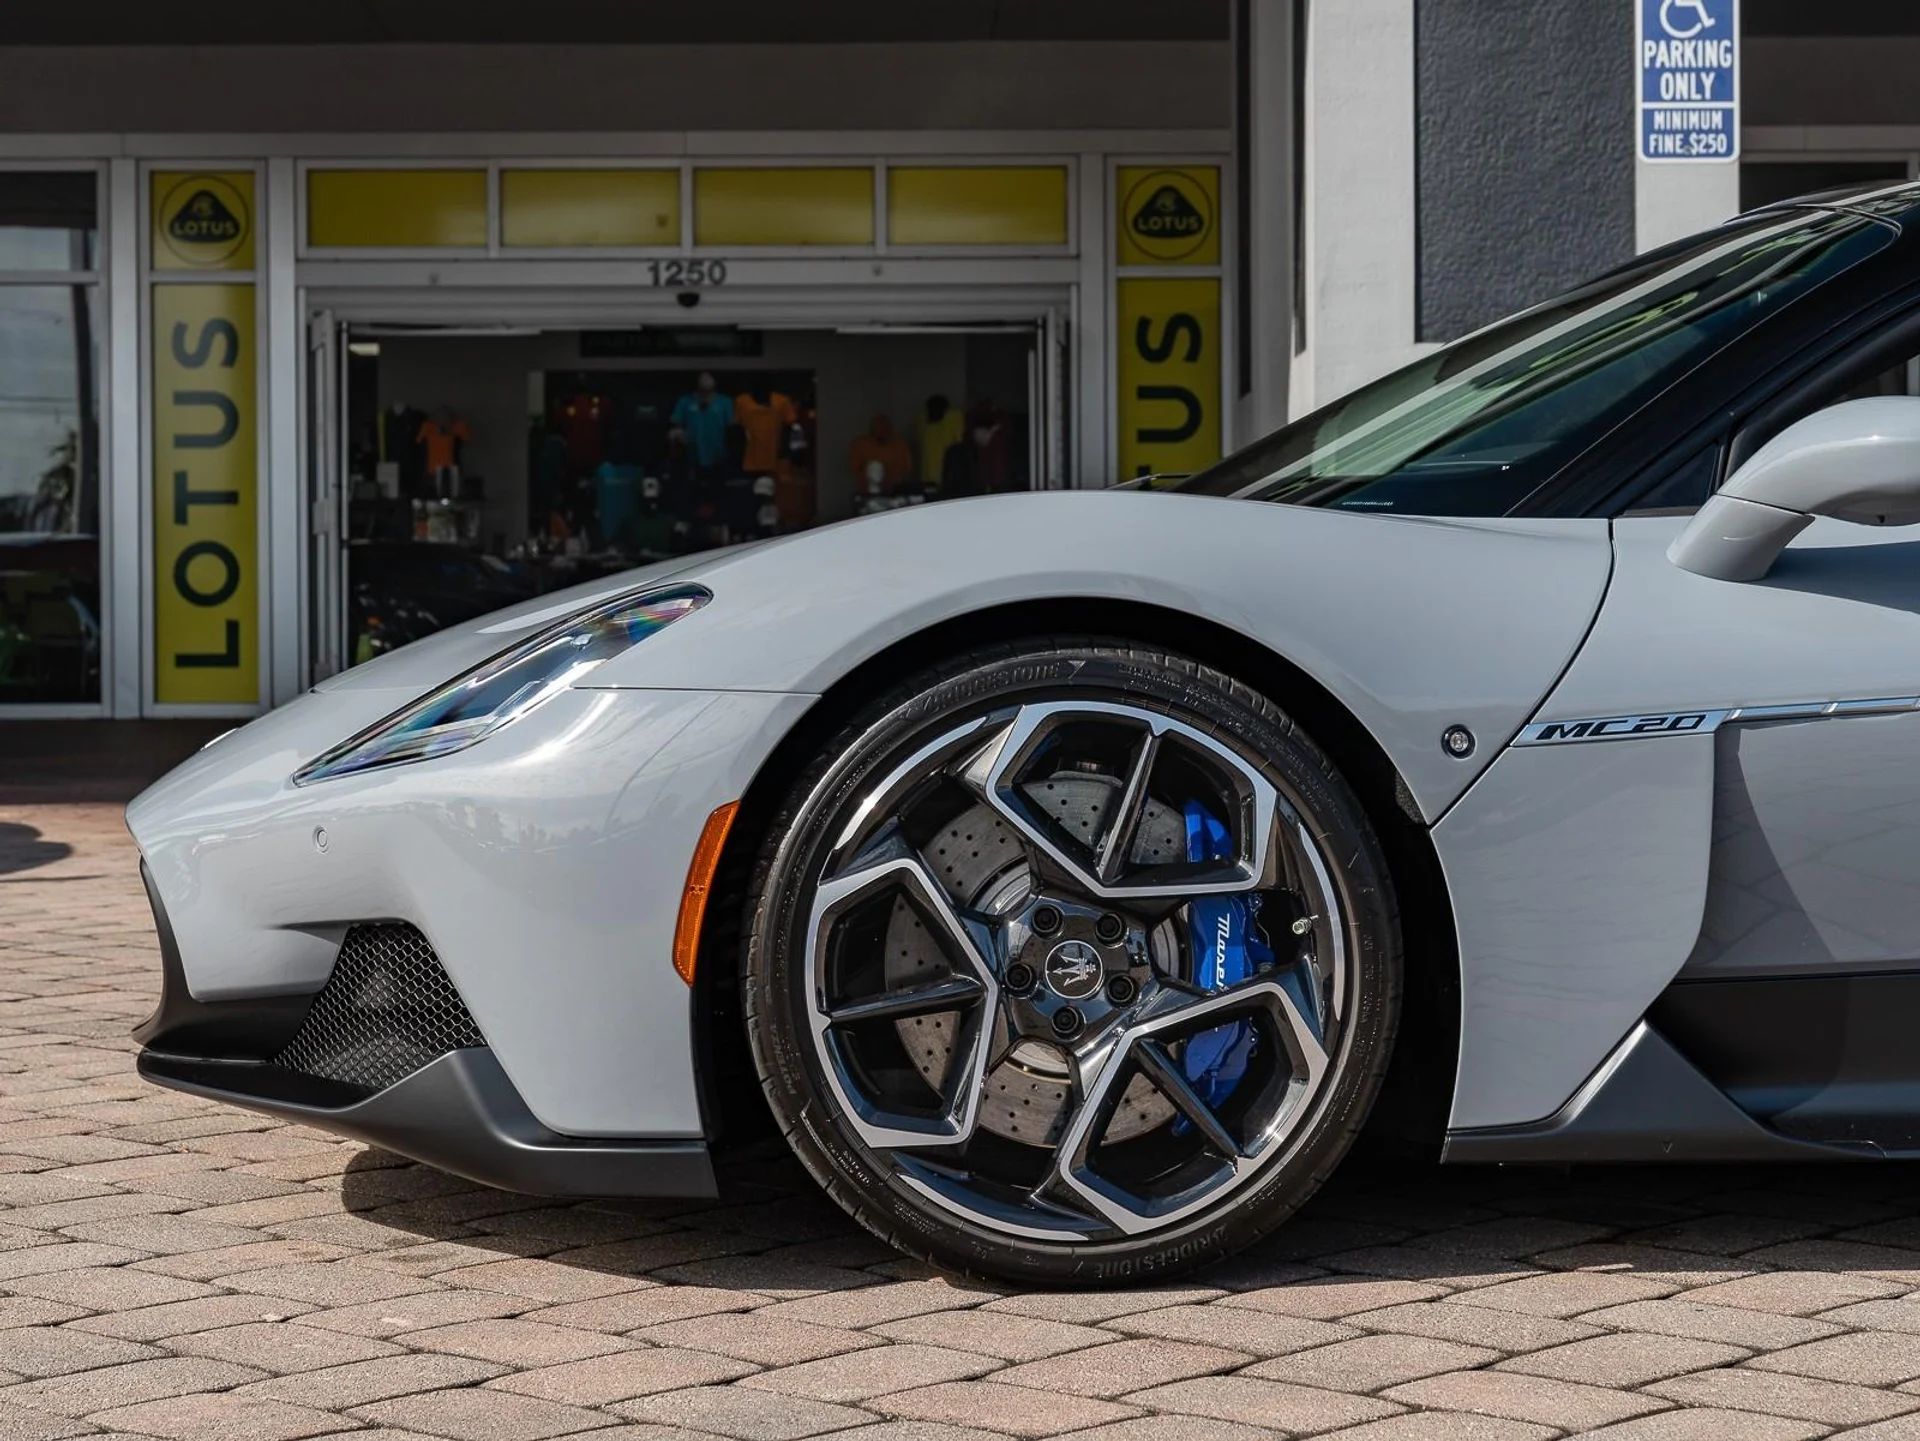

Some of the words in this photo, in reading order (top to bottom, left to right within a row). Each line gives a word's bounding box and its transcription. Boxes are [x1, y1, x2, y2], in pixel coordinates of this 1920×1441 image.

[1644, 40, 1732, 68] PARKING
[1660, 72, 1715, 100] ONLY
[1653, 110, 1723, 131] MINIMUM
[1649, 134, 1684, 154] FINE
[1689, 132, 1728, 155] $250
[173, 220, 236, 236] LOTUS
[1137, 215, 1199, 231] LOTUS
[647, 259, 727, 287] 1250
[171, 317, 240, 668] LOTUS
[1536, 714, 1707, 740] MC20
